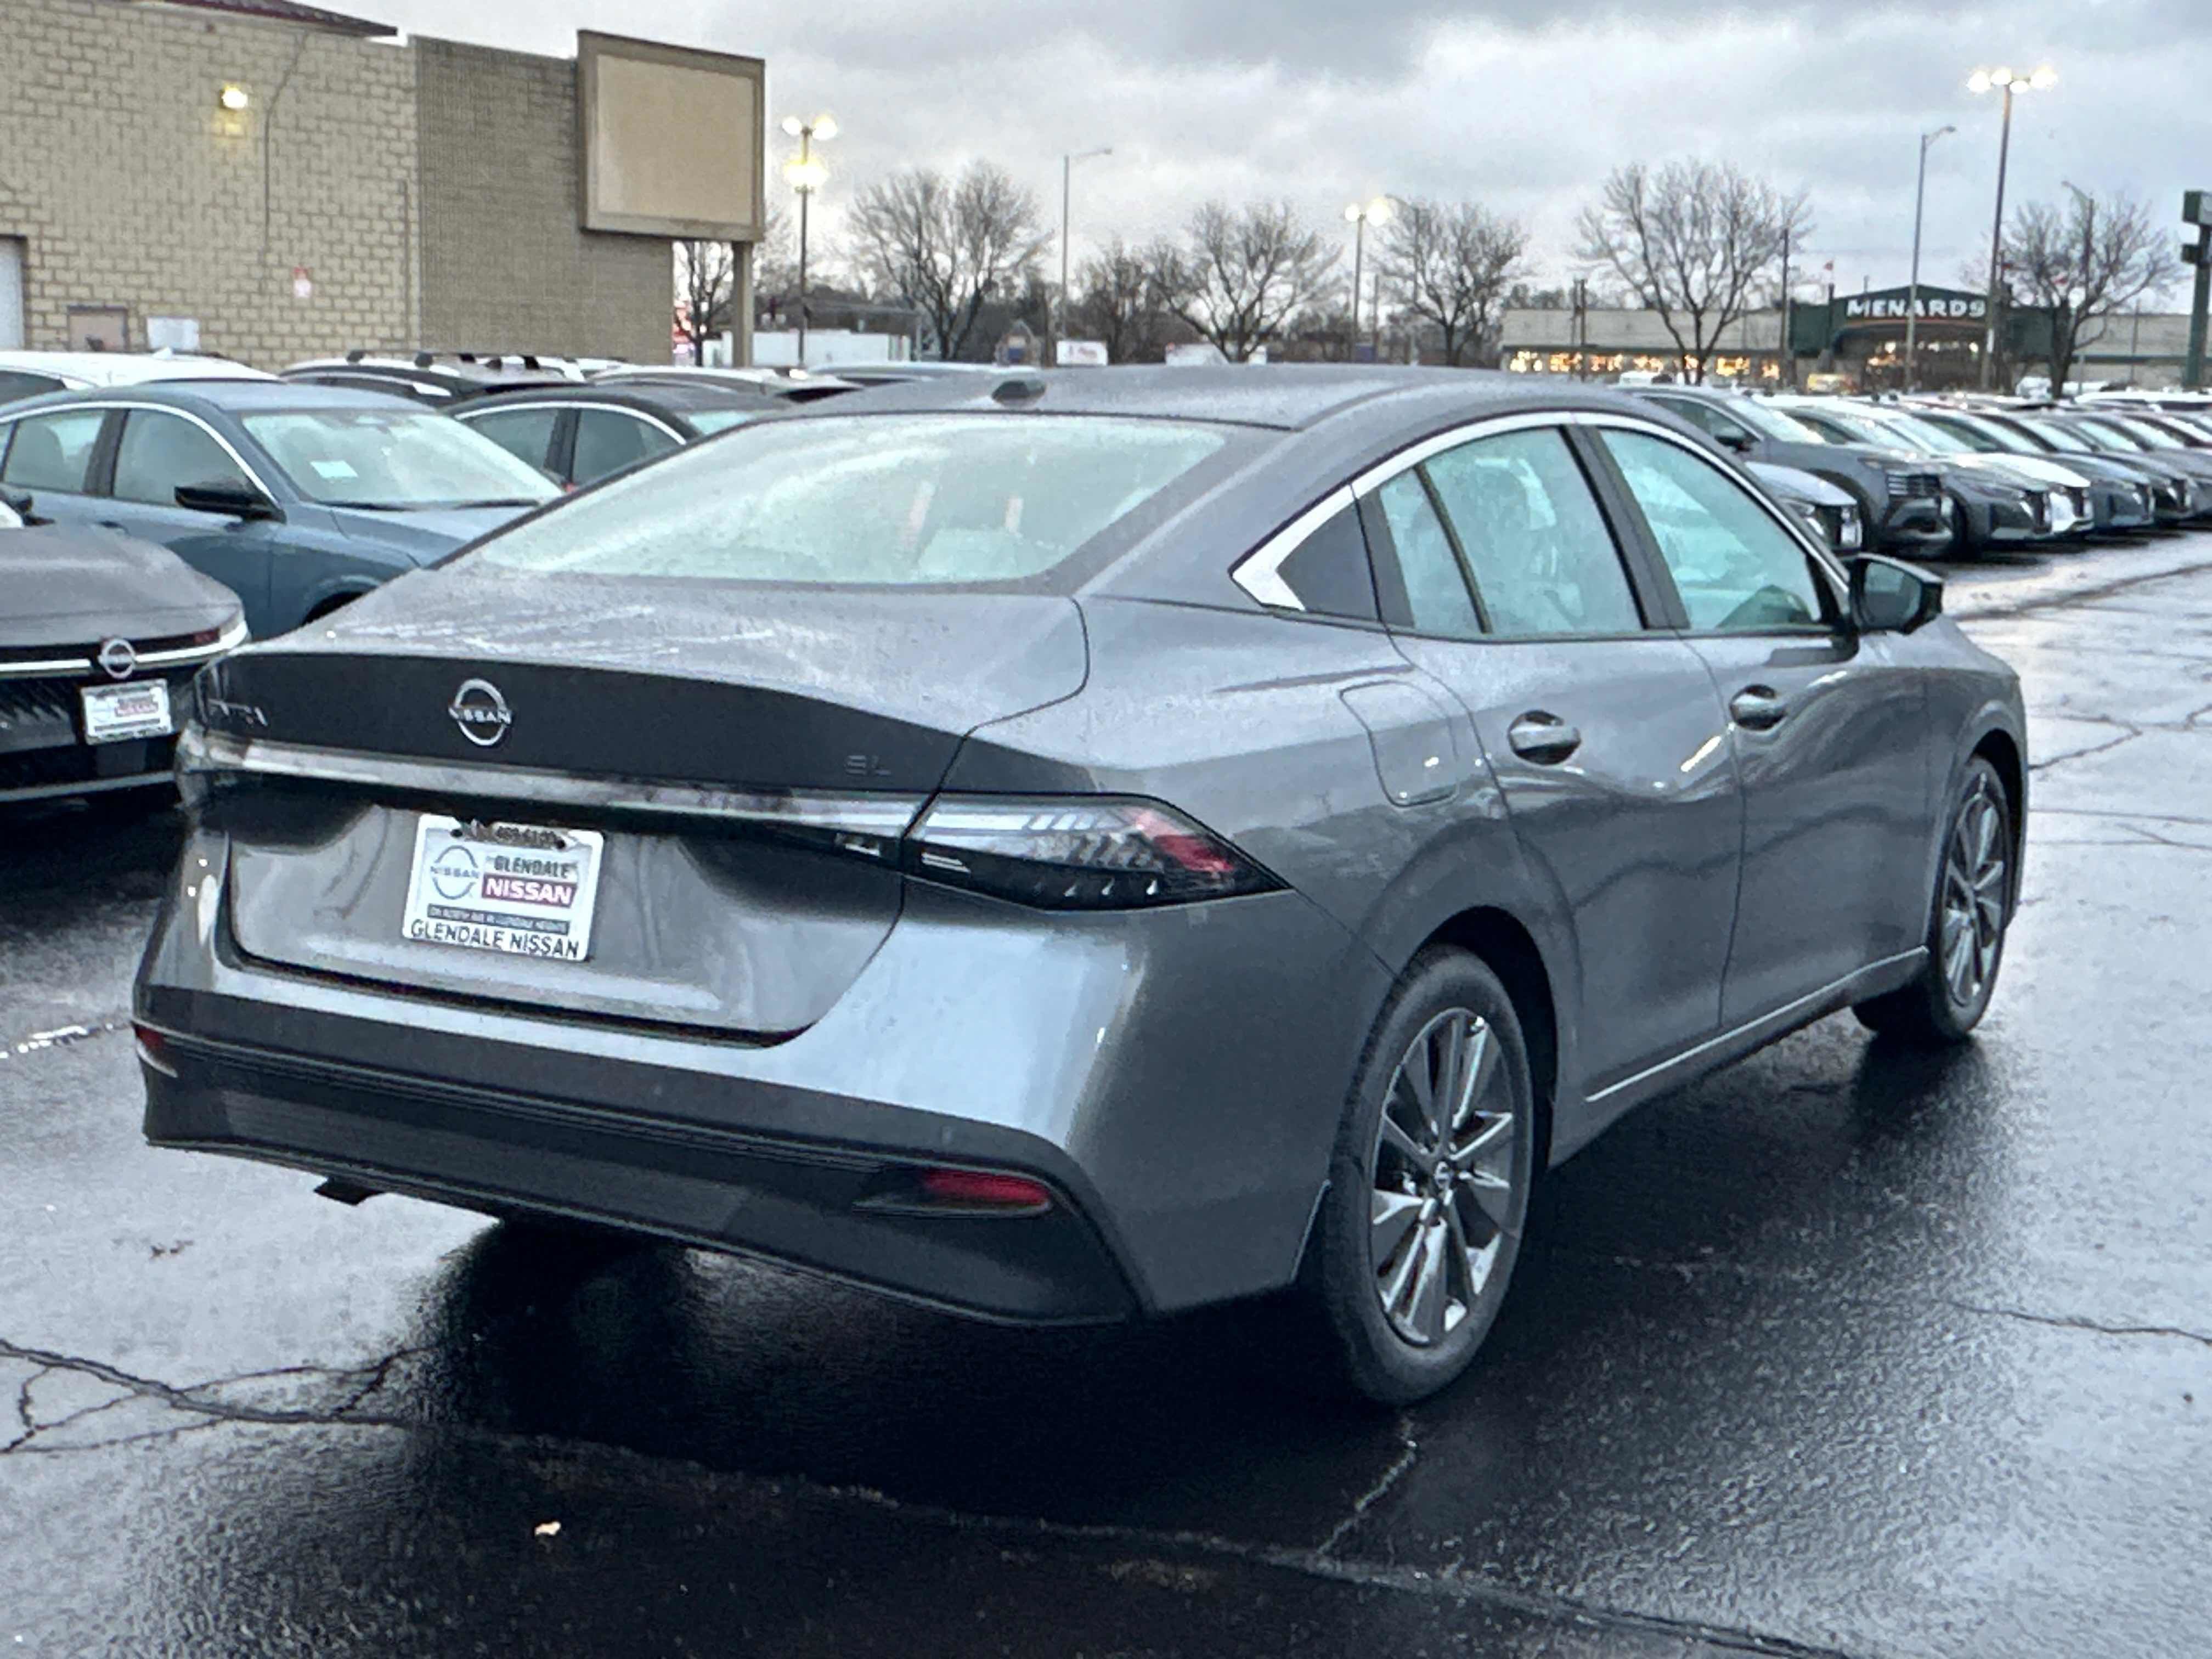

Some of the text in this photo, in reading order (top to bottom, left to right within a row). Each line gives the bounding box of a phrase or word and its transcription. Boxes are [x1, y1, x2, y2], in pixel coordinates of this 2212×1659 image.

[1846, 298, 1986, 318] MENARDS
[493, 855, 577, 879] GLENDALE
[486, 878, 572, 905] NISSAN
[411, 918, 506, 950] GLENDALE
[510, 932, 579, 958] NISSAN
